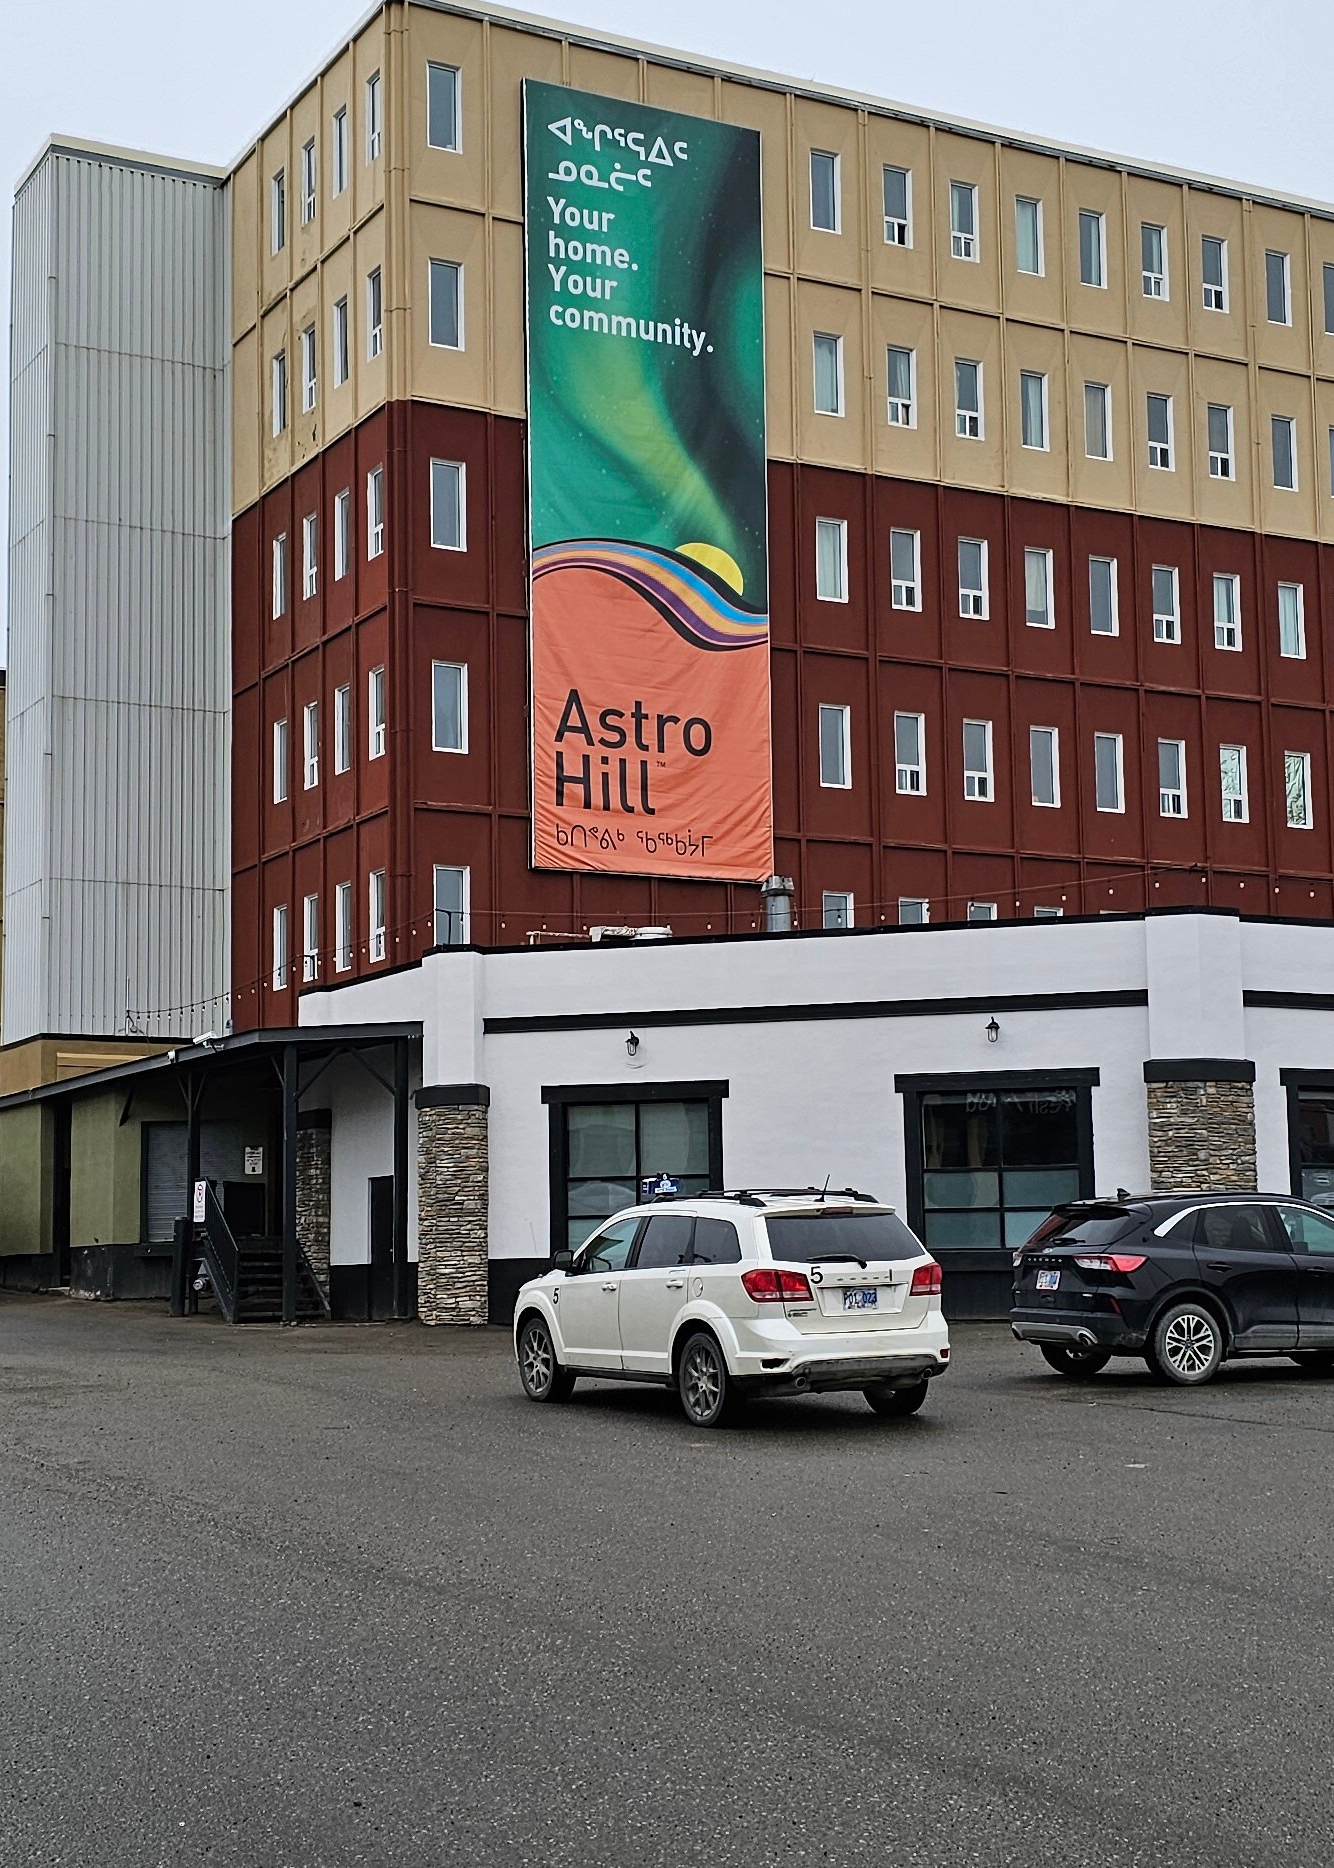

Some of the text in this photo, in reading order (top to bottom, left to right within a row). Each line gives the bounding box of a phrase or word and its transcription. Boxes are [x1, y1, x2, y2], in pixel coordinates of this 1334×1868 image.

[547, 196, 615, 232] Your
[548, 231, 639, 271] home.
[547, 263, 618, 300] Your
[549, 304, 714, 356] community.
[554, 688, 712, 757] Astro
[555, 751, 656, 815] Hill
[810, 1266, 823, 1284] 5
[553, 1287, 560, 1304] 5
